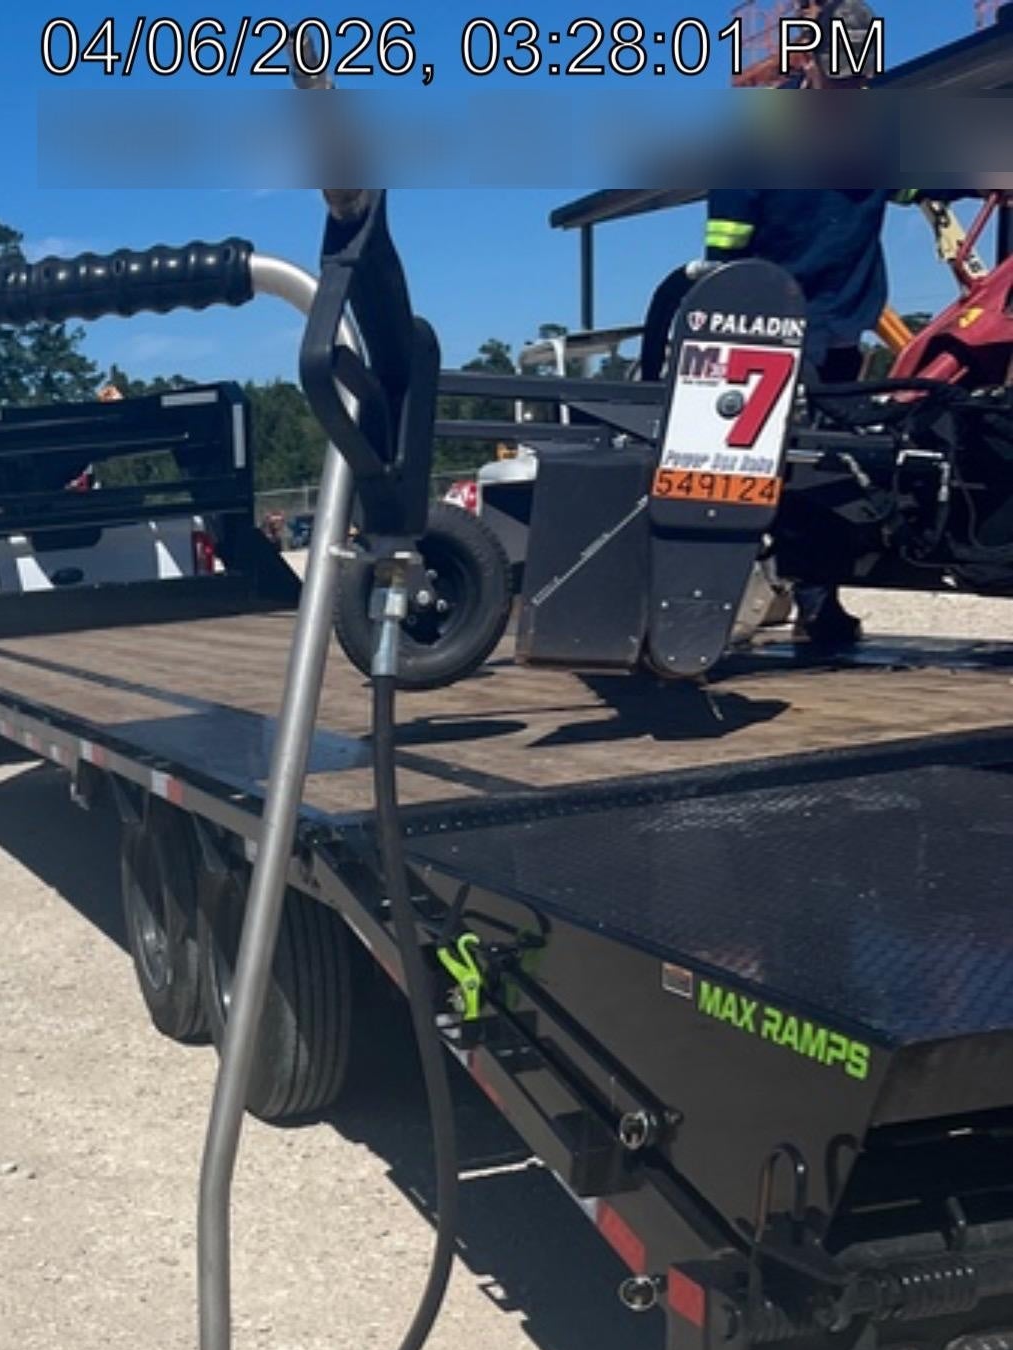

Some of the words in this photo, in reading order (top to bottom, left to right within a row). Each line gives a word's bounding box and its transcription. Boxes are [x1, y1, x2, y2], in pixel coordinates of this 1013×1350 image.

[710, 311, 804, 337] PALADIN
[655, 469, 777, 503] 549124
[697, 980, 757, 1033] MAX
[761, 1006, 871, 1080] RAMPS
